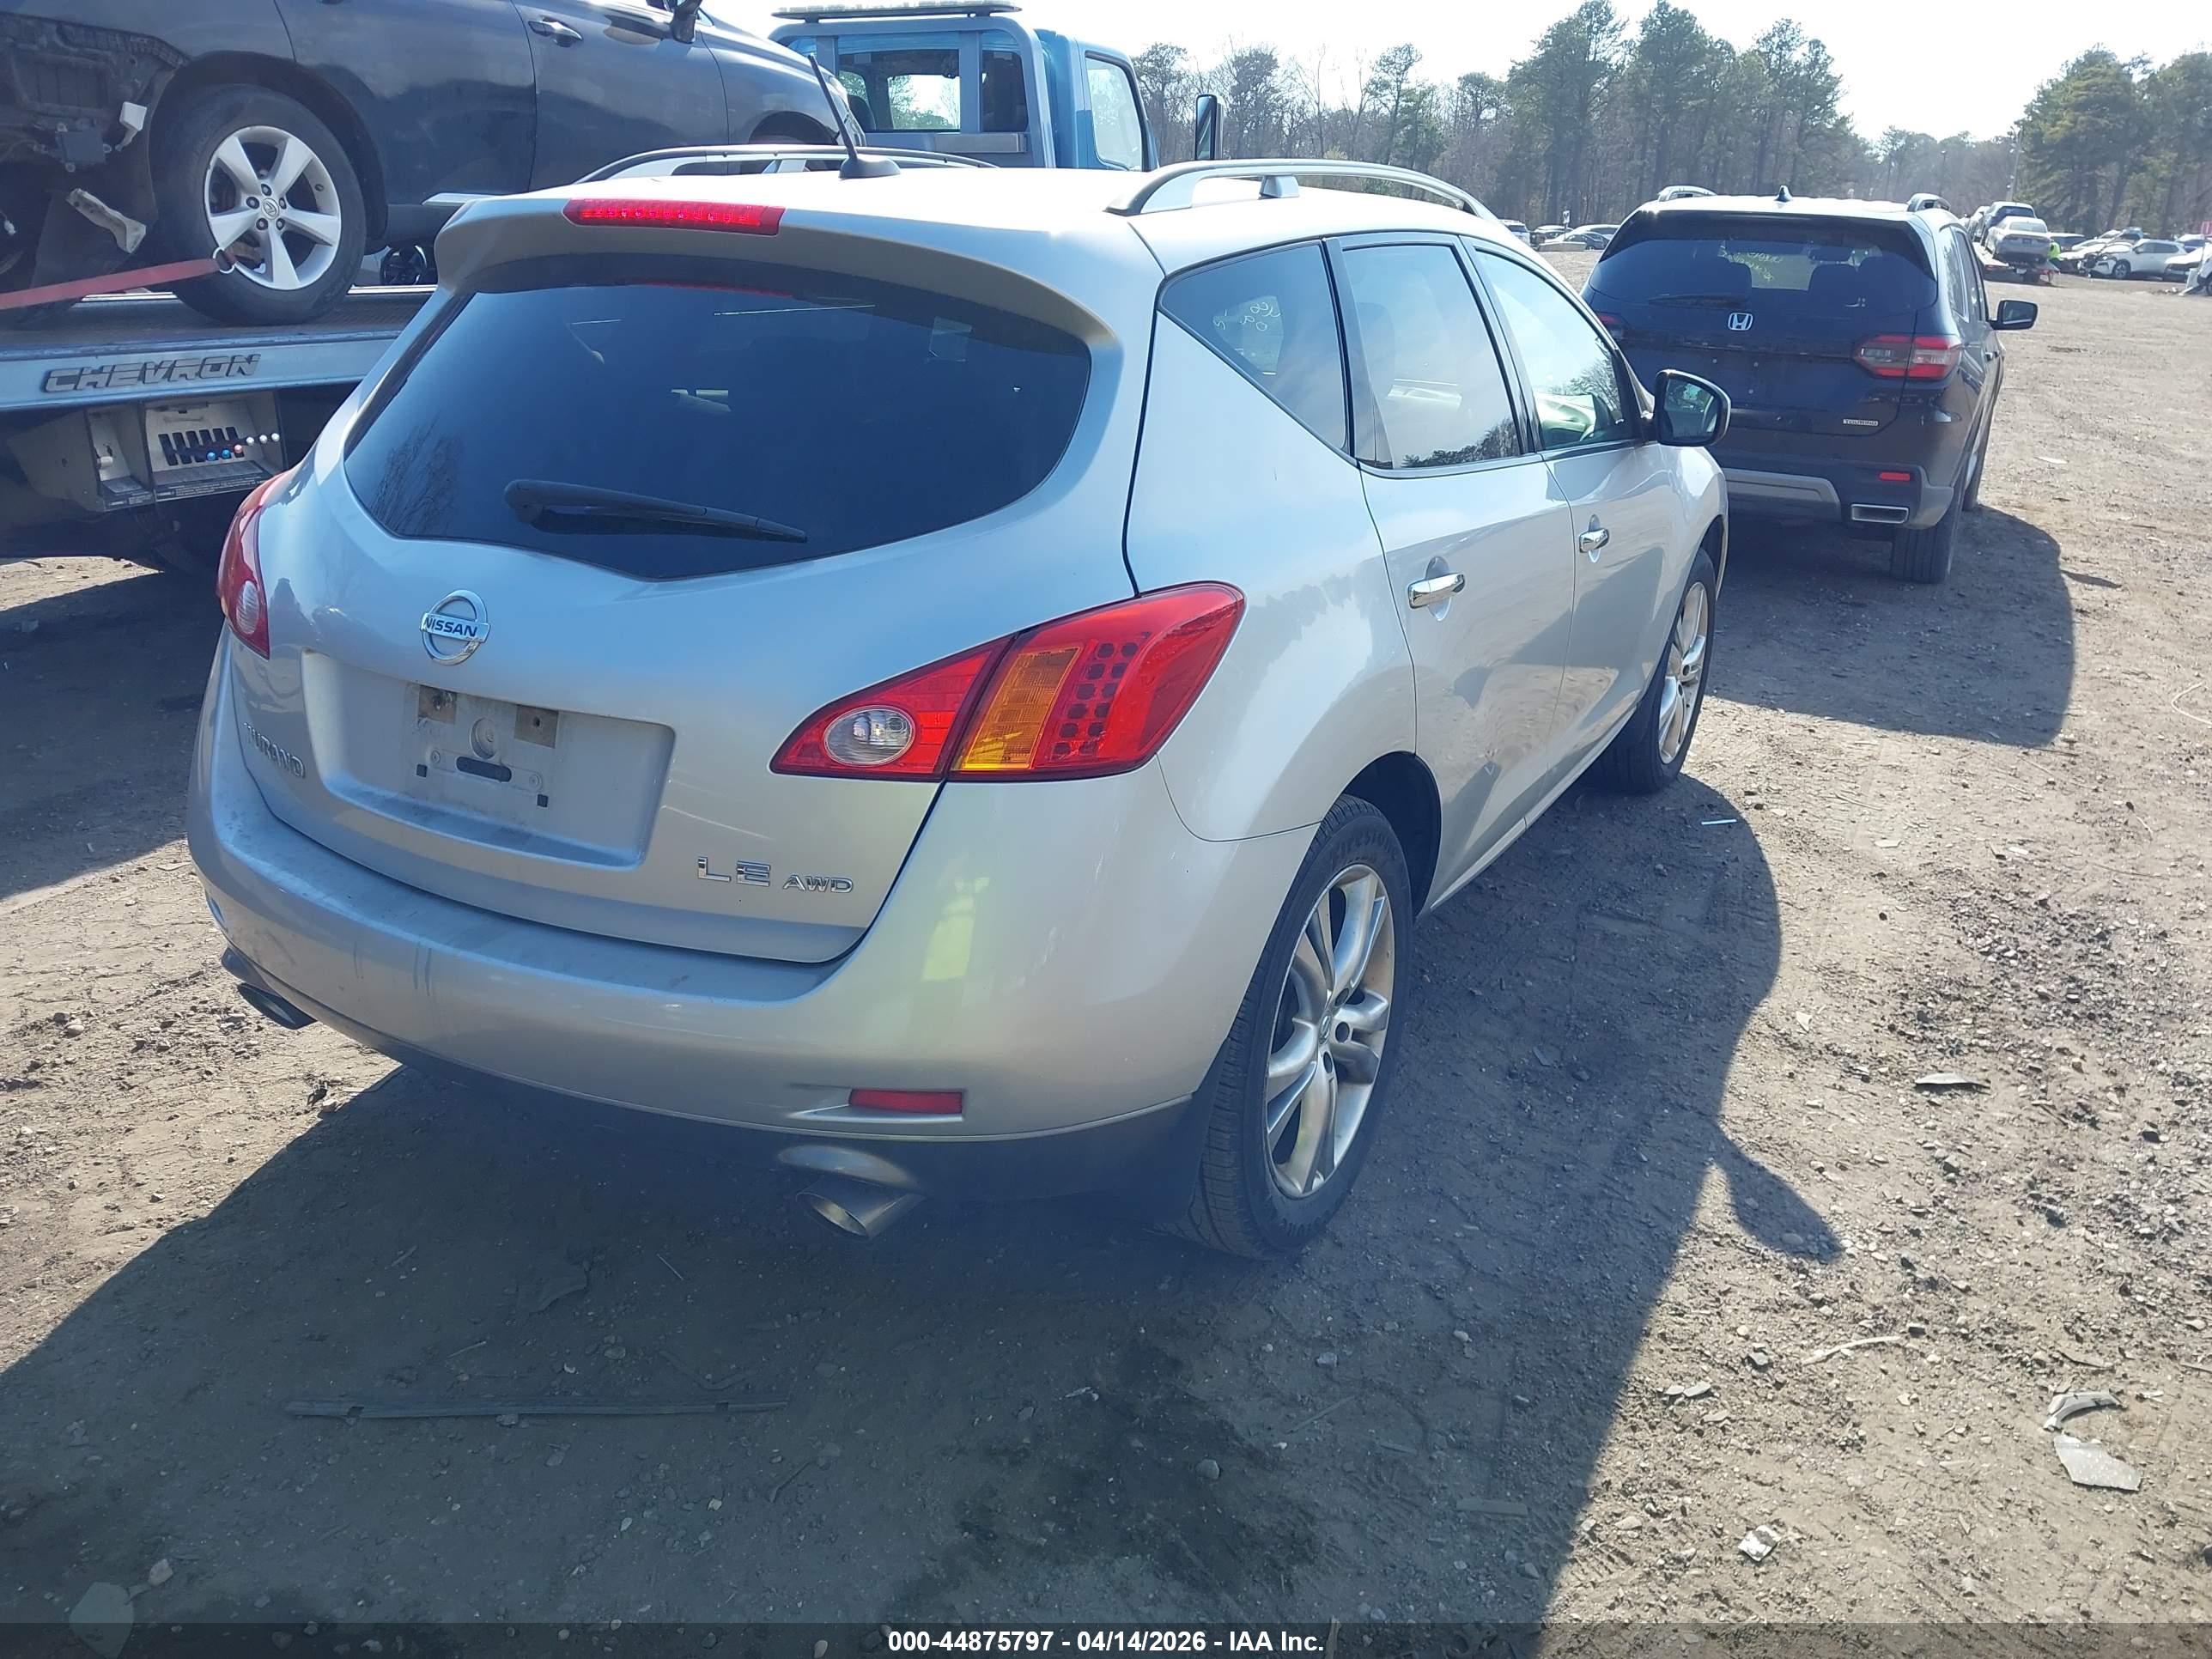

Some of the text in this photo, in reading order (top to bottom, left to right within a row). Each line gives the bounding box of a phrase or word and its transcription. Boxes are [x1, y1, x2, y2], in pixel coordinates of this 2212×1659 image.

[43, 354, 261, 392] CHEVRON
[424, 617, 478, 638] NISSAN
[697, 856, 854, 894] LE AWD
